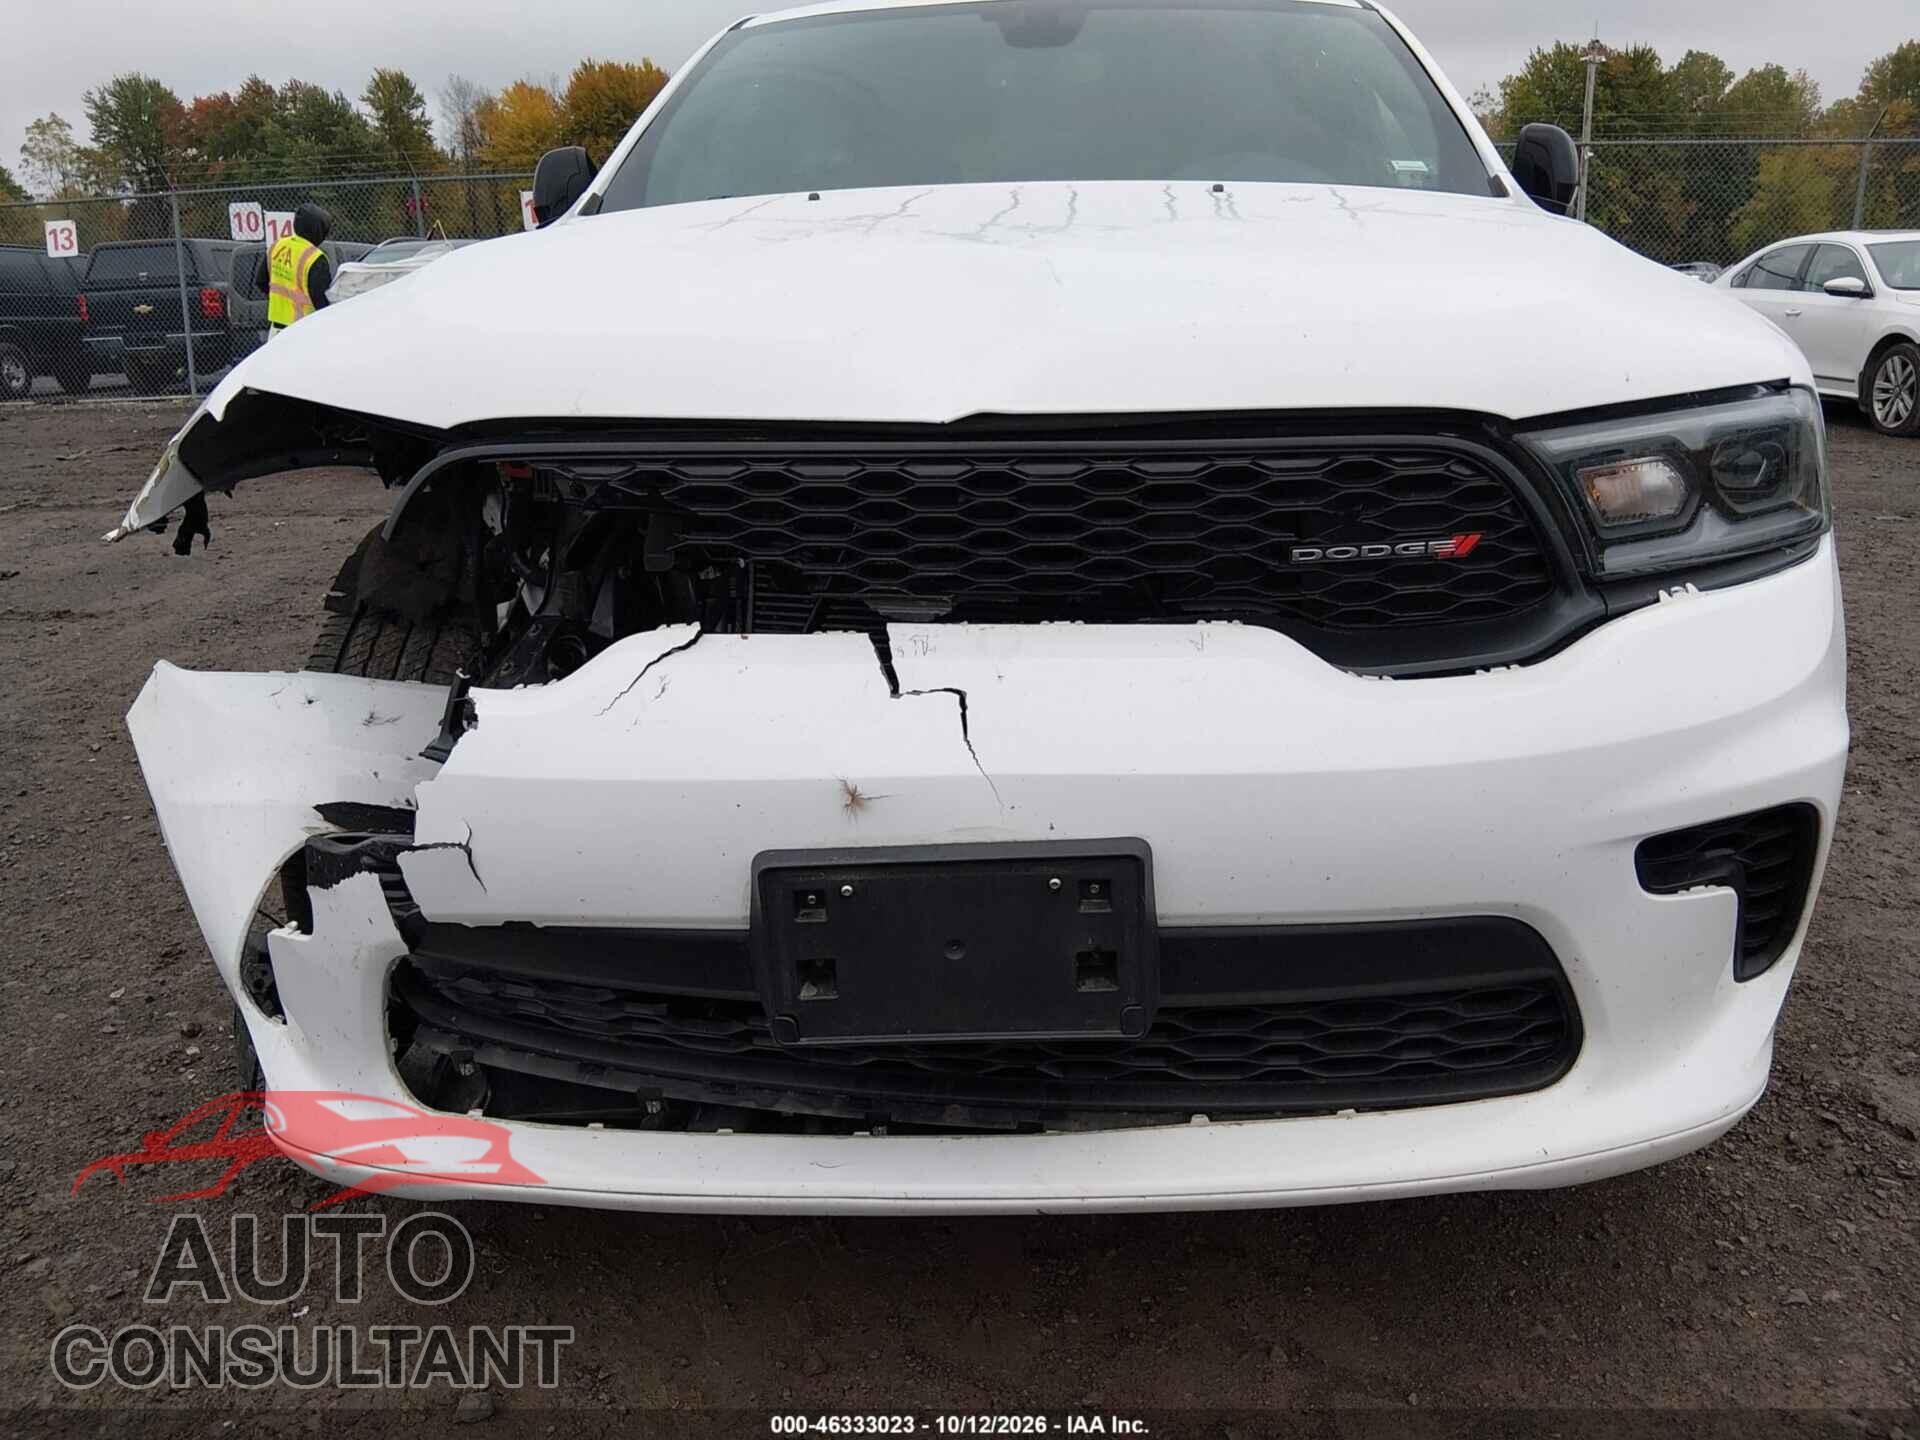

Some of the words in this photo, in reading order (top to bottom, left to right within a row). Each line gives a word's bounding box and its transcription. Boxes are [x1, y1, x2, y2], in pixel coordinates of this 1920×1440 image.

[233, 211, 260, 233] 10
[267, 219, 293, 244] 14
[48, 228, 75, 251] 13
[1291, 539, 1457, 562] DODGE
